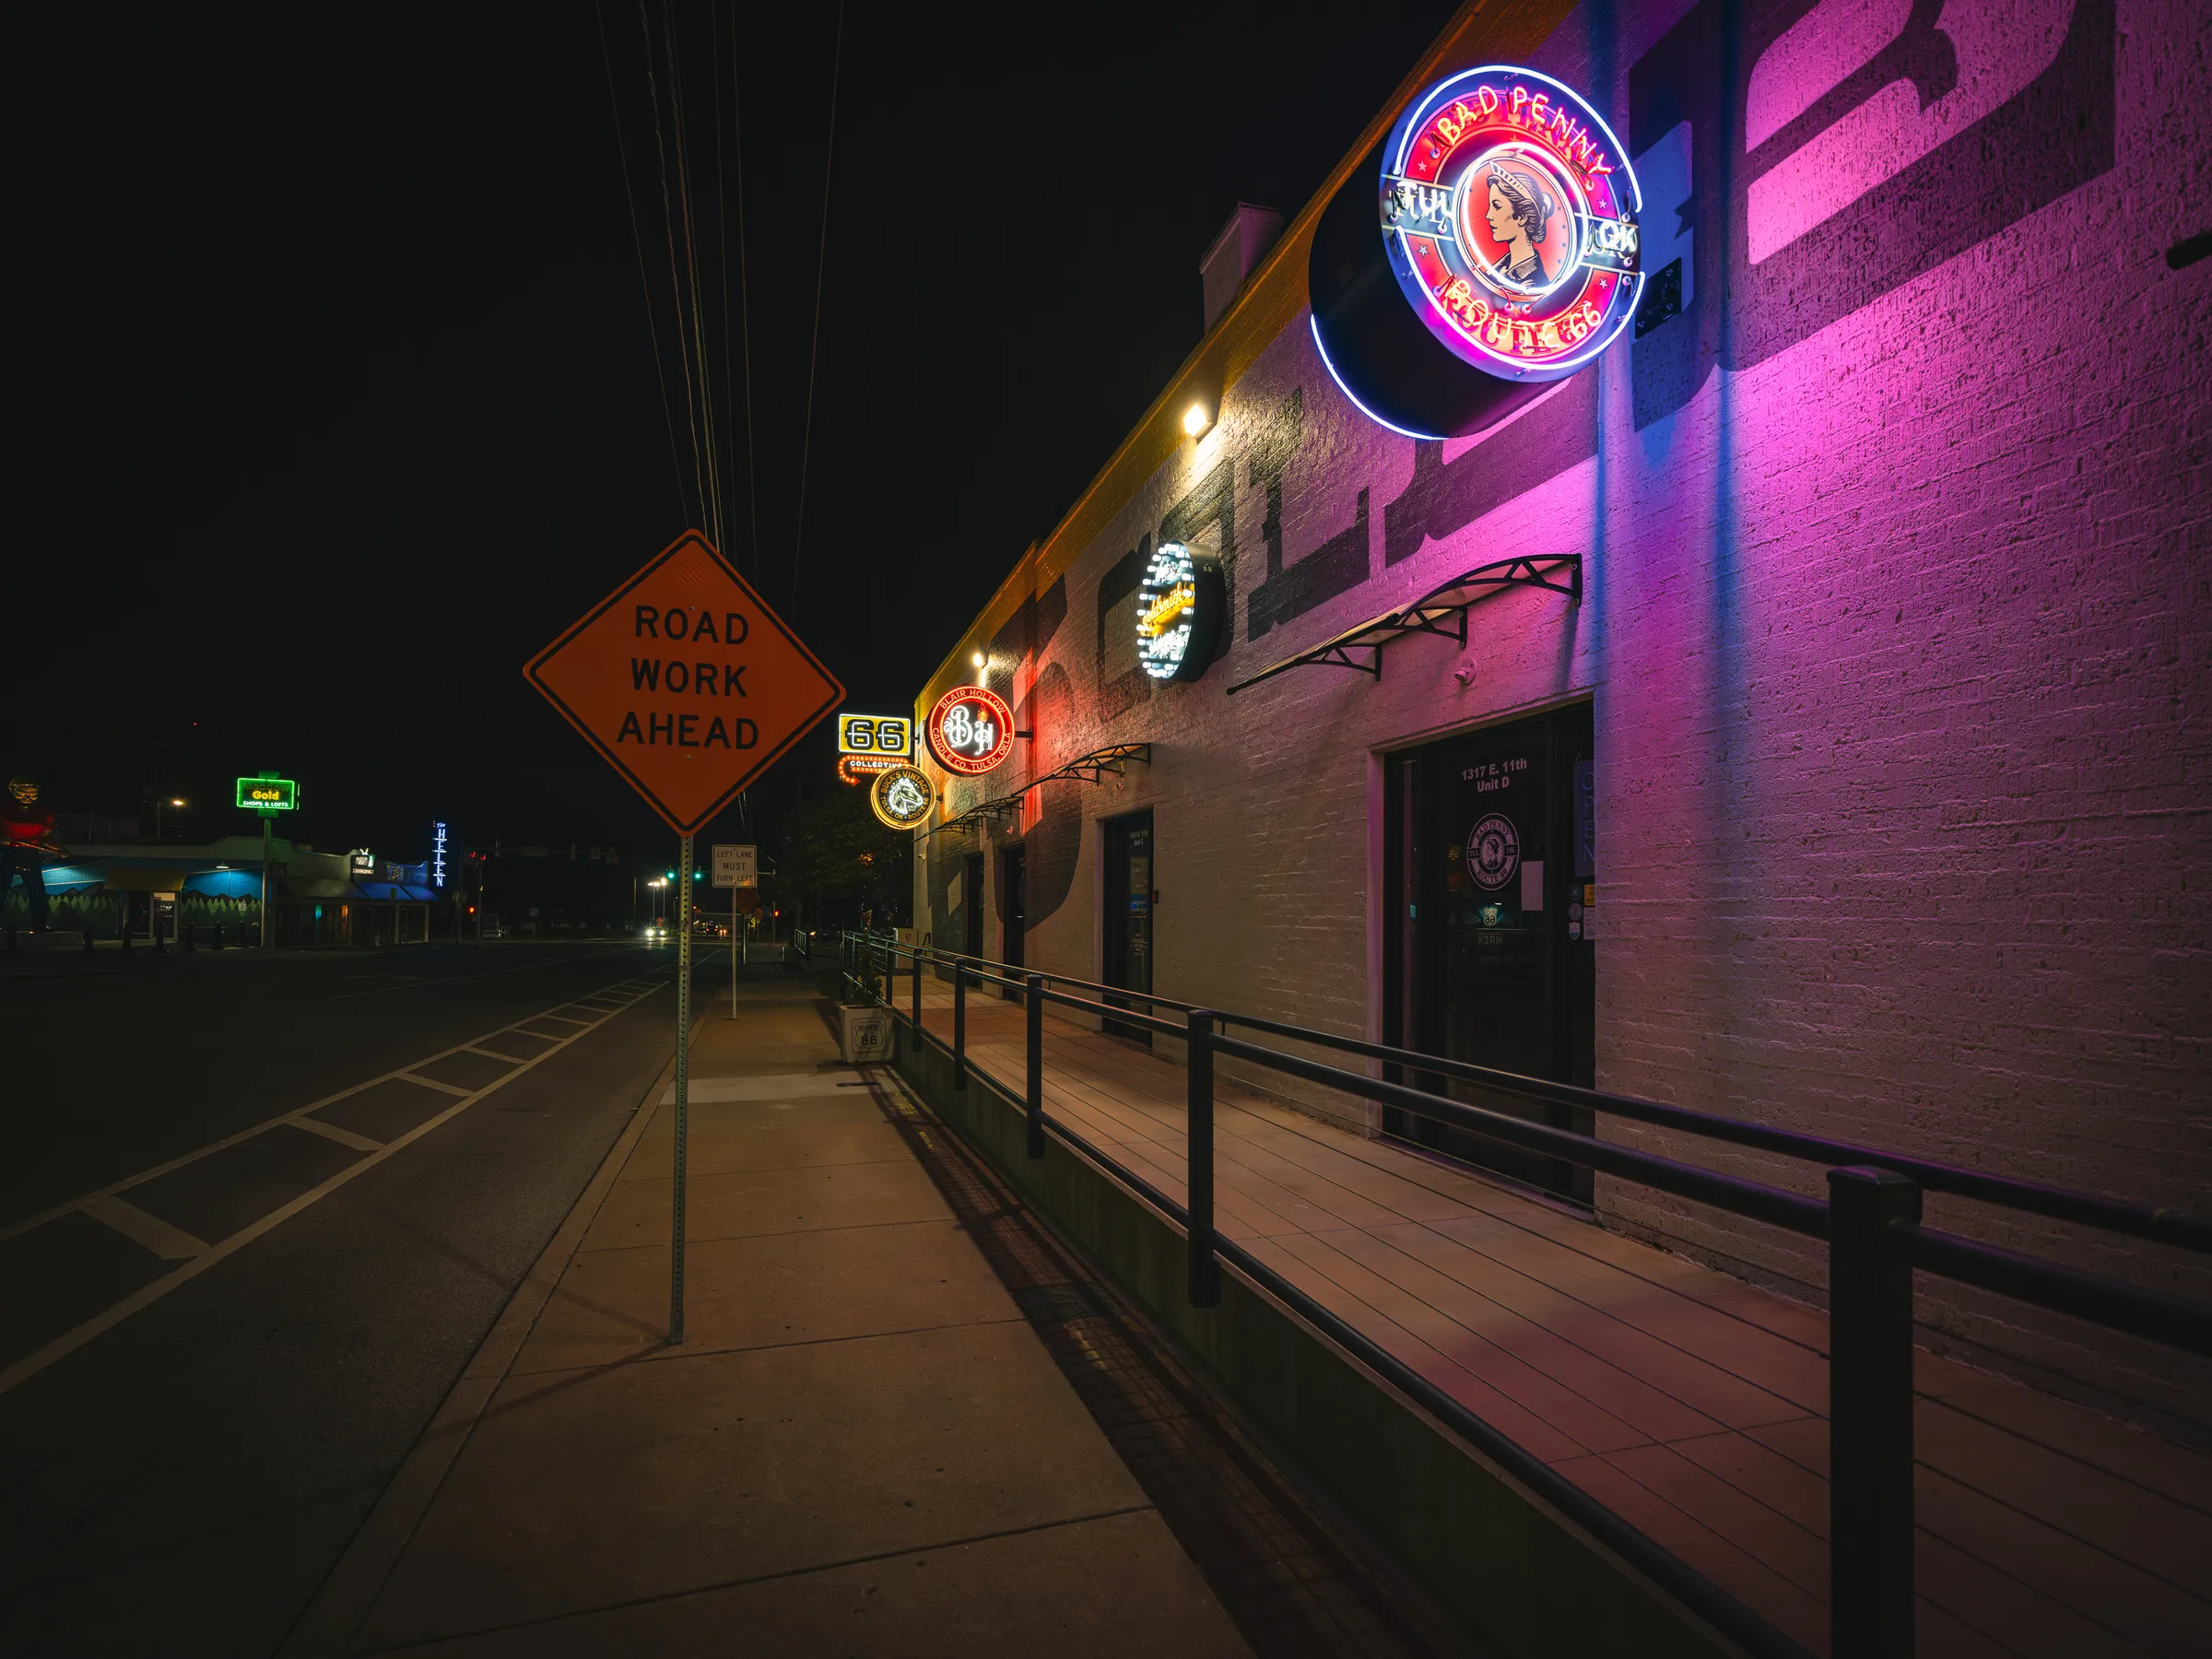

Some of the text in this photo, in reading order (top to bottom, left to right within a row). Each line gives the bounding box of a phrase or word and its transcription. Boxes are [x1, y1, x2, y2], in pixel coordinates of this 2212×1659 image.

[1437, 85, 1613, 176] BAD PENNY
[1394, 181, 1638, 259] TUL OK
[1443, 278, 1603, 352] ROUTE 66
[635, 605, 748, 645] ROAD
[630, 658, 748, 698] WORK
[940, 689, 1006, 713] BLAIR HOLLOW
[616, 711, 759, 750] AHEAD
[845, 718, 905, 752] 66
[932, 727, 1012, 771] CANDLE CO. TULSA, OKLA
[1462, 758, 1527, 781] 1317 E. 11th
[880, 771, 929, 794] BUCK'S VINTAGE
[1477, 776, 1510, 793] Unit D
[252, 790, 279, 800] Gold
[908, 805, 926, 819] ROUTE
[924, 797, 929, 806] 66
[1475, 820, 1511, 841] BAD PENNY
[723, 862, 746, 871] MUST
[1477, 869, 1500, 884] ROUTE
